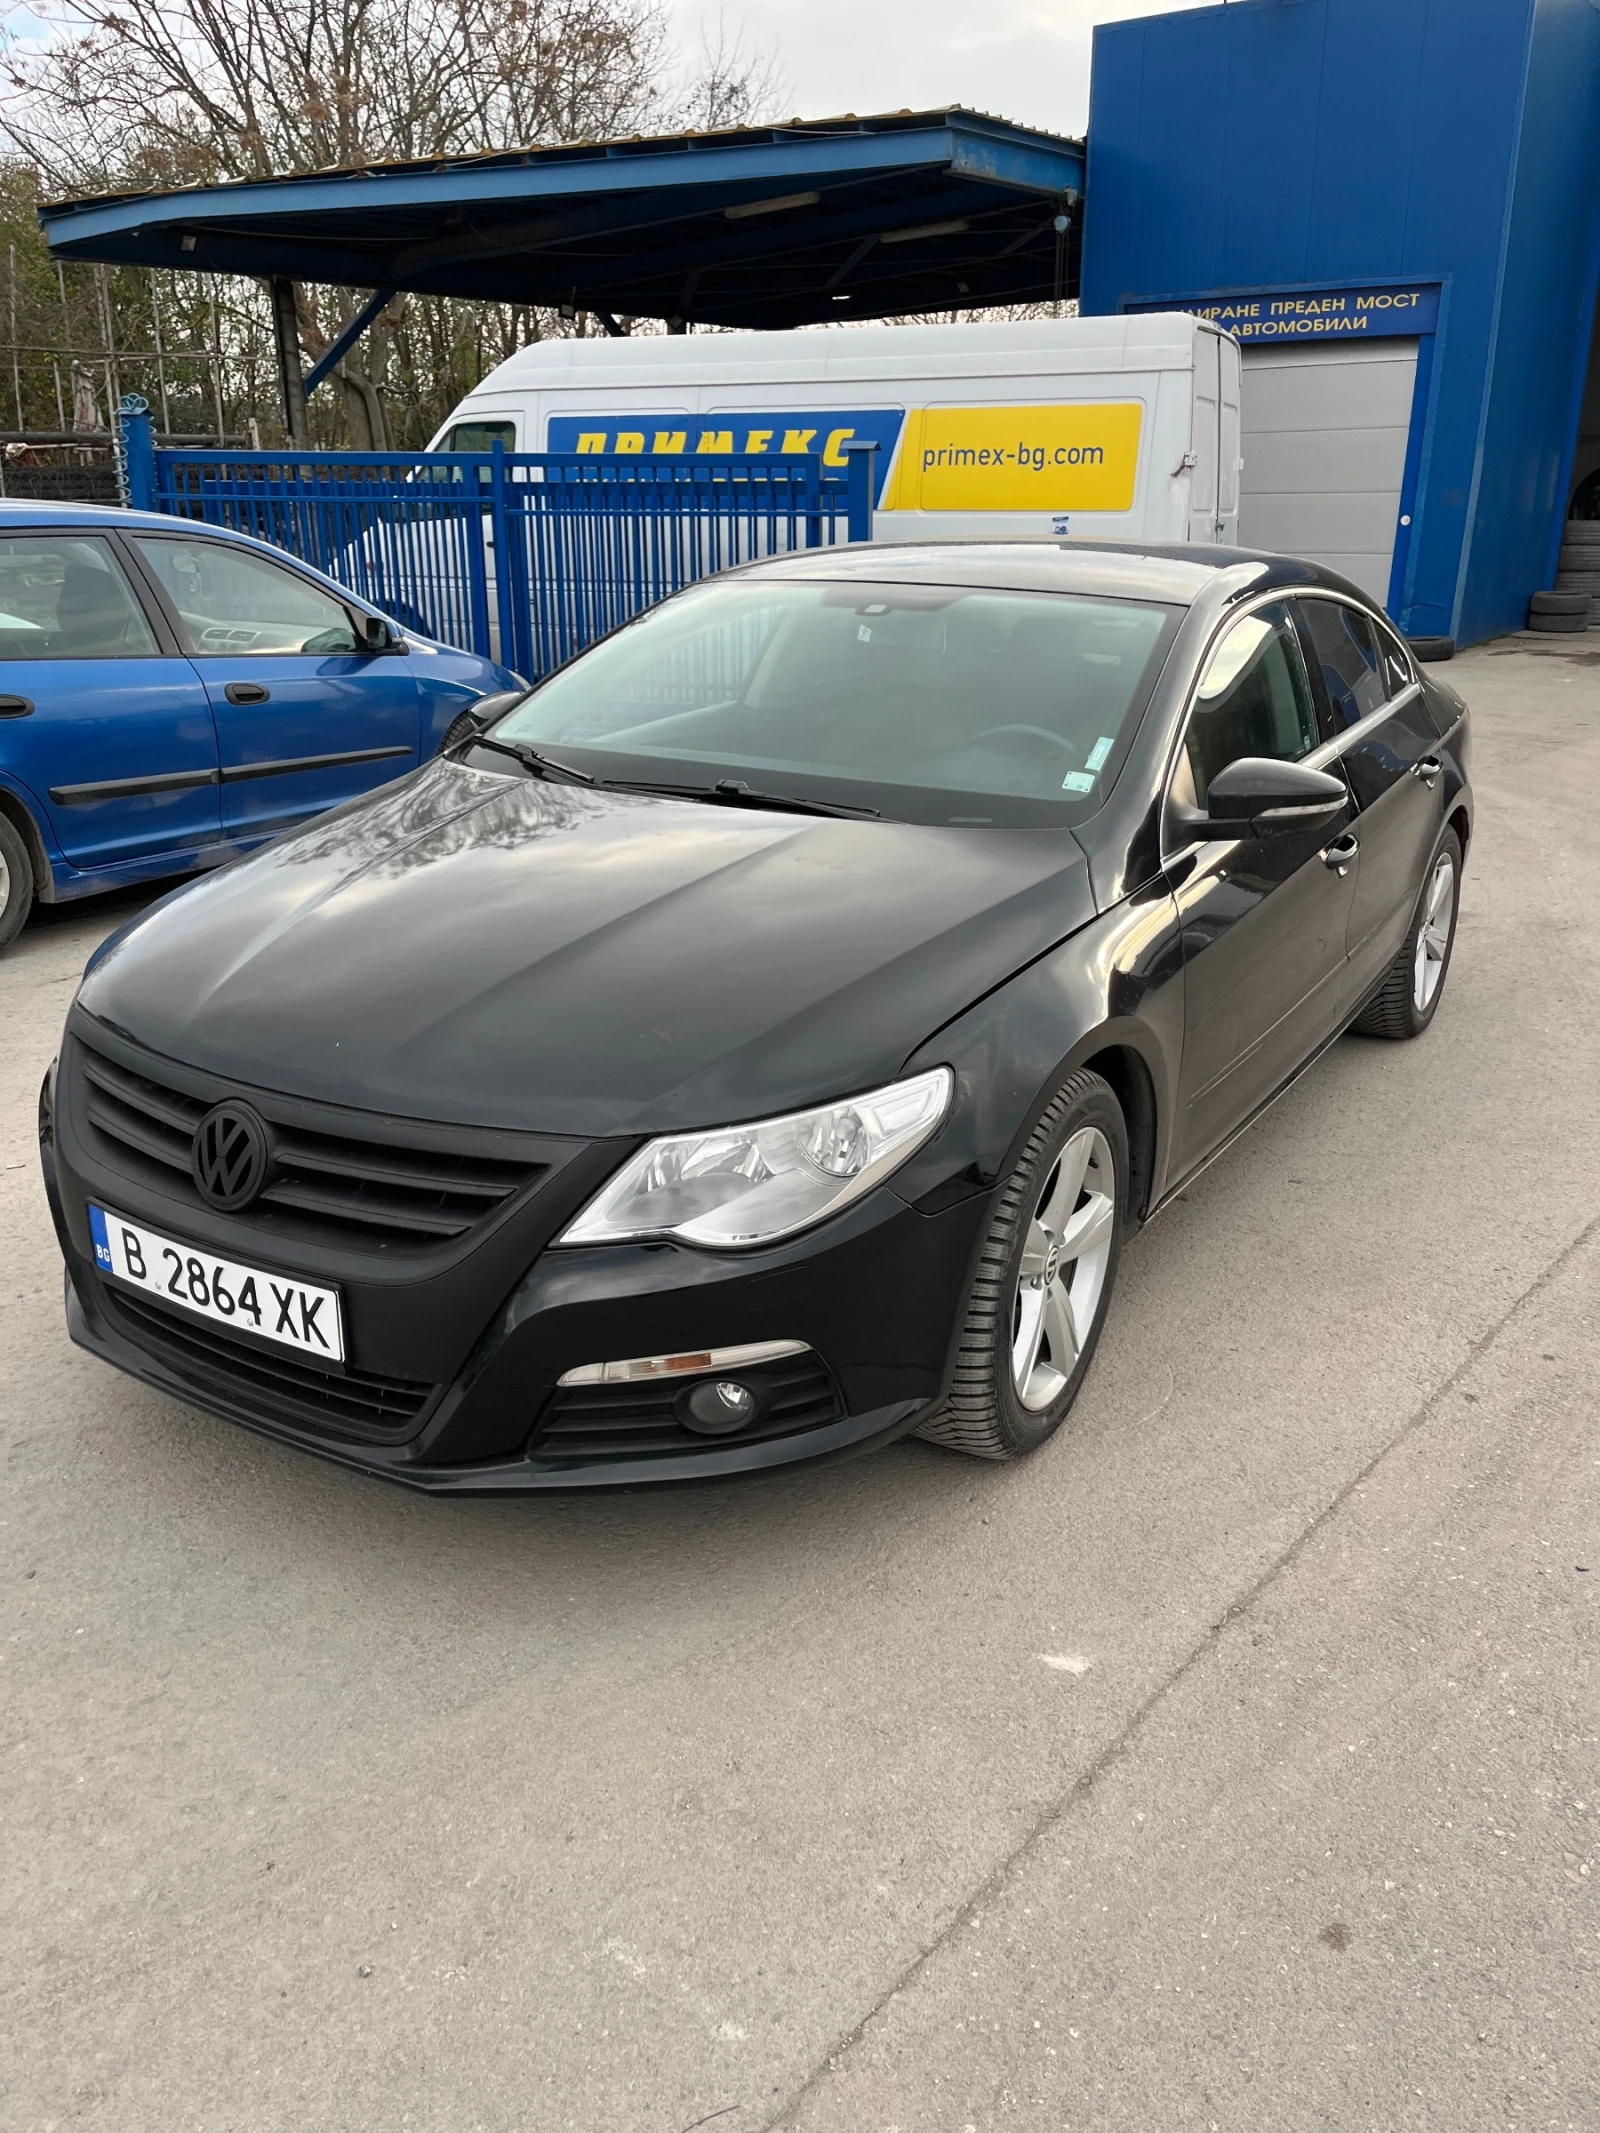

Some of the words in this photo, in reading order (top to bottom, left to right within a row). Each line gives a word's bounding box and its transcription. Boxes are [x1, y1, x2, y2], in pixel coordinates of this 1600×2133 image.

[1270, 298, 1346, 316] ПРЕДЕН
[1356, 293, 1420, 310] МОСТ
[1230, 316, 1368, 336] АВТОМОБИЛИ
[922, 441, 1104, 472] primex-bg.com
[95, 1243, 112, 1264] BG
[121, 1227, 148, 1281] B
[162, 1247, 263, 1326] 2864
[269, 1282, 331, 1349] XK
